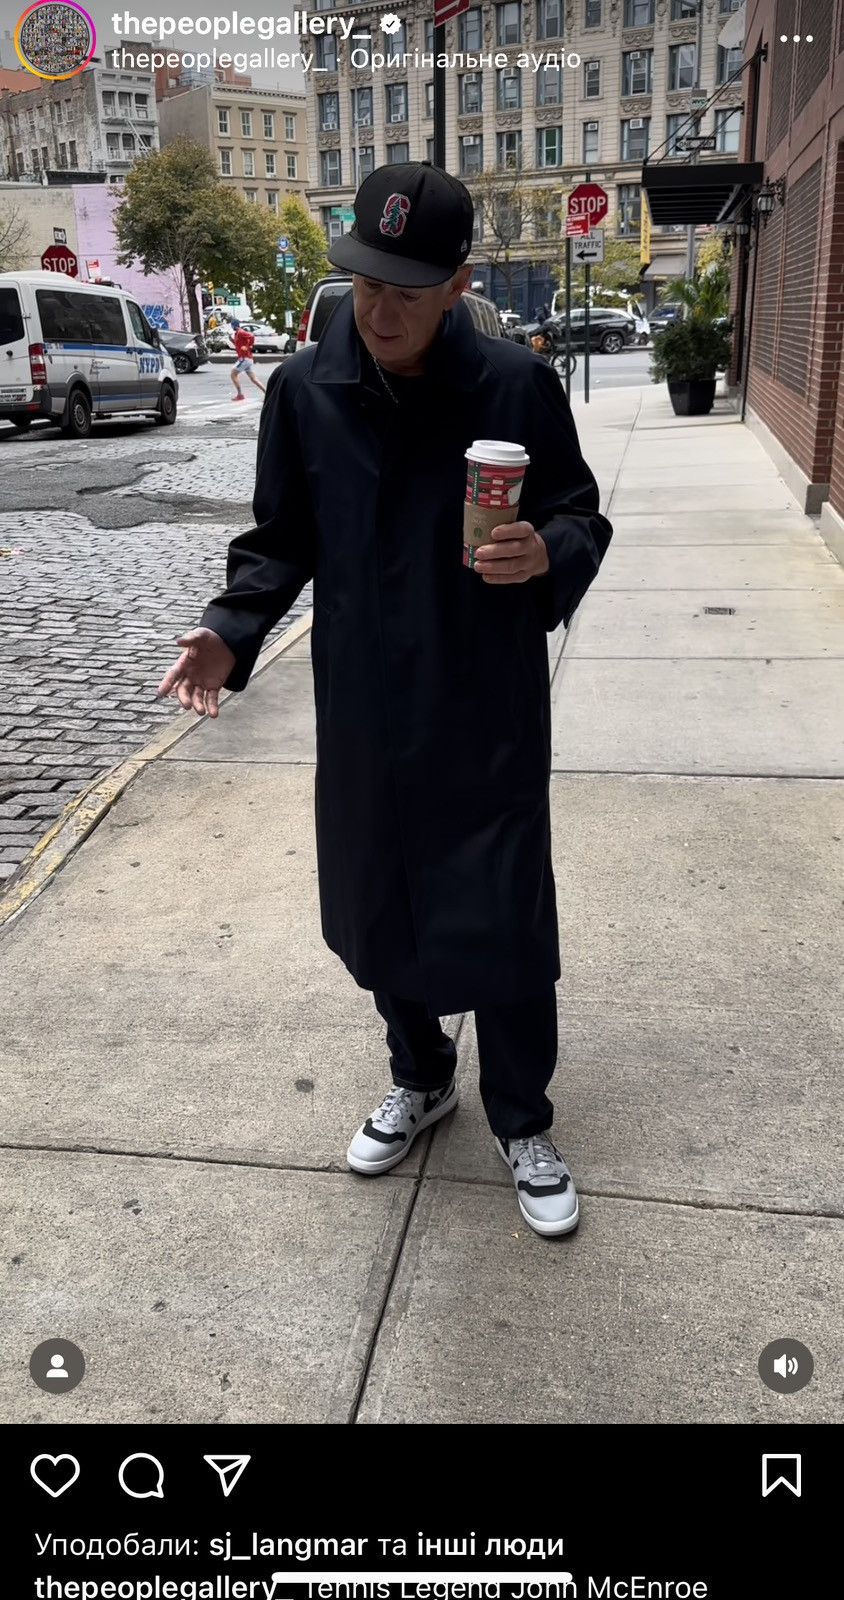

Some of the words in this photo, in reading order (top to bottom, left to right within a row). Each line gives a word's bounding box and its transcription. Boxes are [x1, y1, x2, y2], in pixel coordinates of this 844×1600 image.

[569, 196, 606, 214] STOP
[574, 240, 602, 249] TRAFFIC
[43, 257, 76, 273] STOP
[139, 357, 160, 374] NYPD
